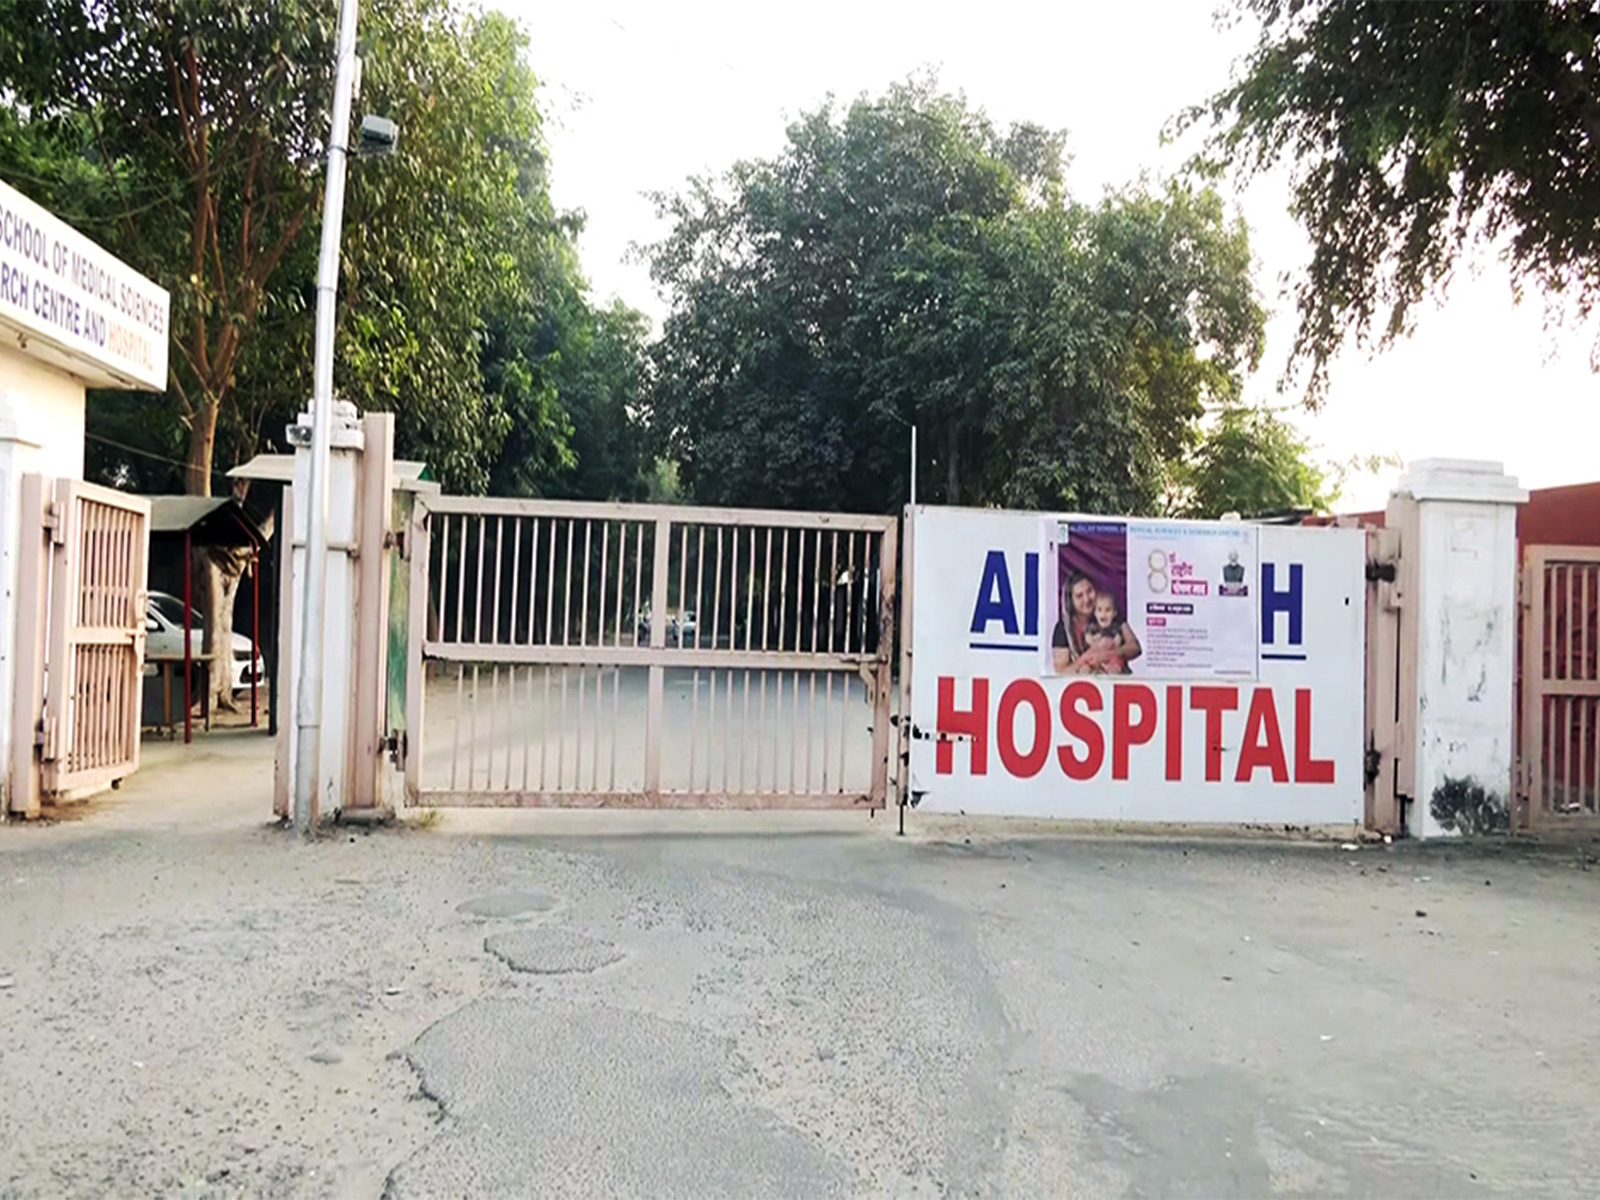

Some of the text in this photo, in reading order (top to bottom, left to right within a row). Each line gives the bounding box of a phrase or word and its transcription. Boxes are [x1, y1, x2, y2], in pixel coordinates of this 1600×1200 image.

[33, 279, 80, 336] CENTRE
[83, 307, 106, 347] AND
[108, 321, 154, 371] HOSPITAL
[53, 240, 68, 278] OF
[72, 251, 117, 309] MEDICAL
[120, 282, 164, 335] SCIENCES
[935, 675, 1335, 784] HOSPITAL
